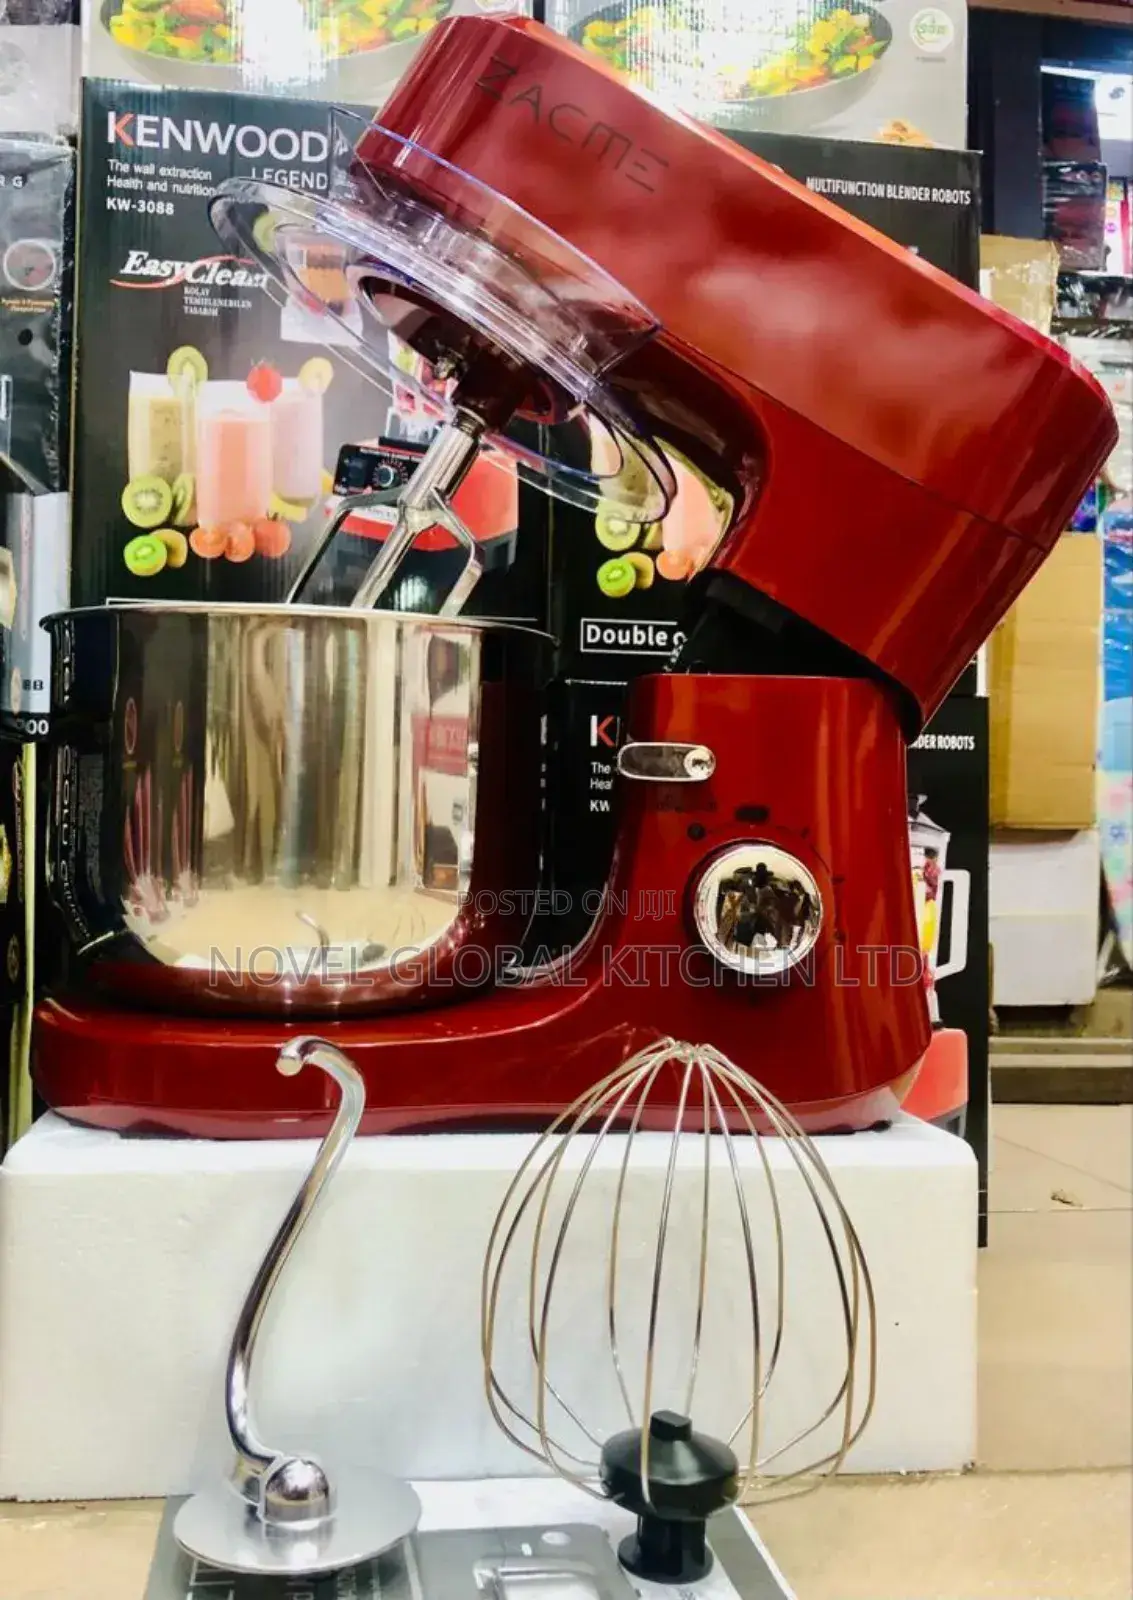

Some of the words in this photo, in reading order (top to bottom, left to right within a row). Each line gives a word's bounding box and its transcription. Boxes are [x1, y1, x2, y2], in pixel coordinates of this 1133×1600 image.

[474, 54, 670, 195] ZACME
[107, 111, 328, 163] KENWOOD
[107, 158, 130, 173] The
[133, 163, 155, 175] wall
[158, 166, 212, 181] extraction
[251, 167, 328, 191] LEGEND
[107, 174, 143, 191] Health
[146, 180, 168, 193] and
[172, 182, 216, 198] nutrition
[806, 176, 885, 198] MULTIFUNCTION
[886, 184, 930, 201] BLENDER
[932, 188, 971, 206] ROBOTS
[106, 197, 175, 216] KW-3088
[586, 624, 668, 646] Double
[590, 714, 620, 747] K
[937, 734, 975, 751] ROBOTS
[590, 761, 611, 774] The
